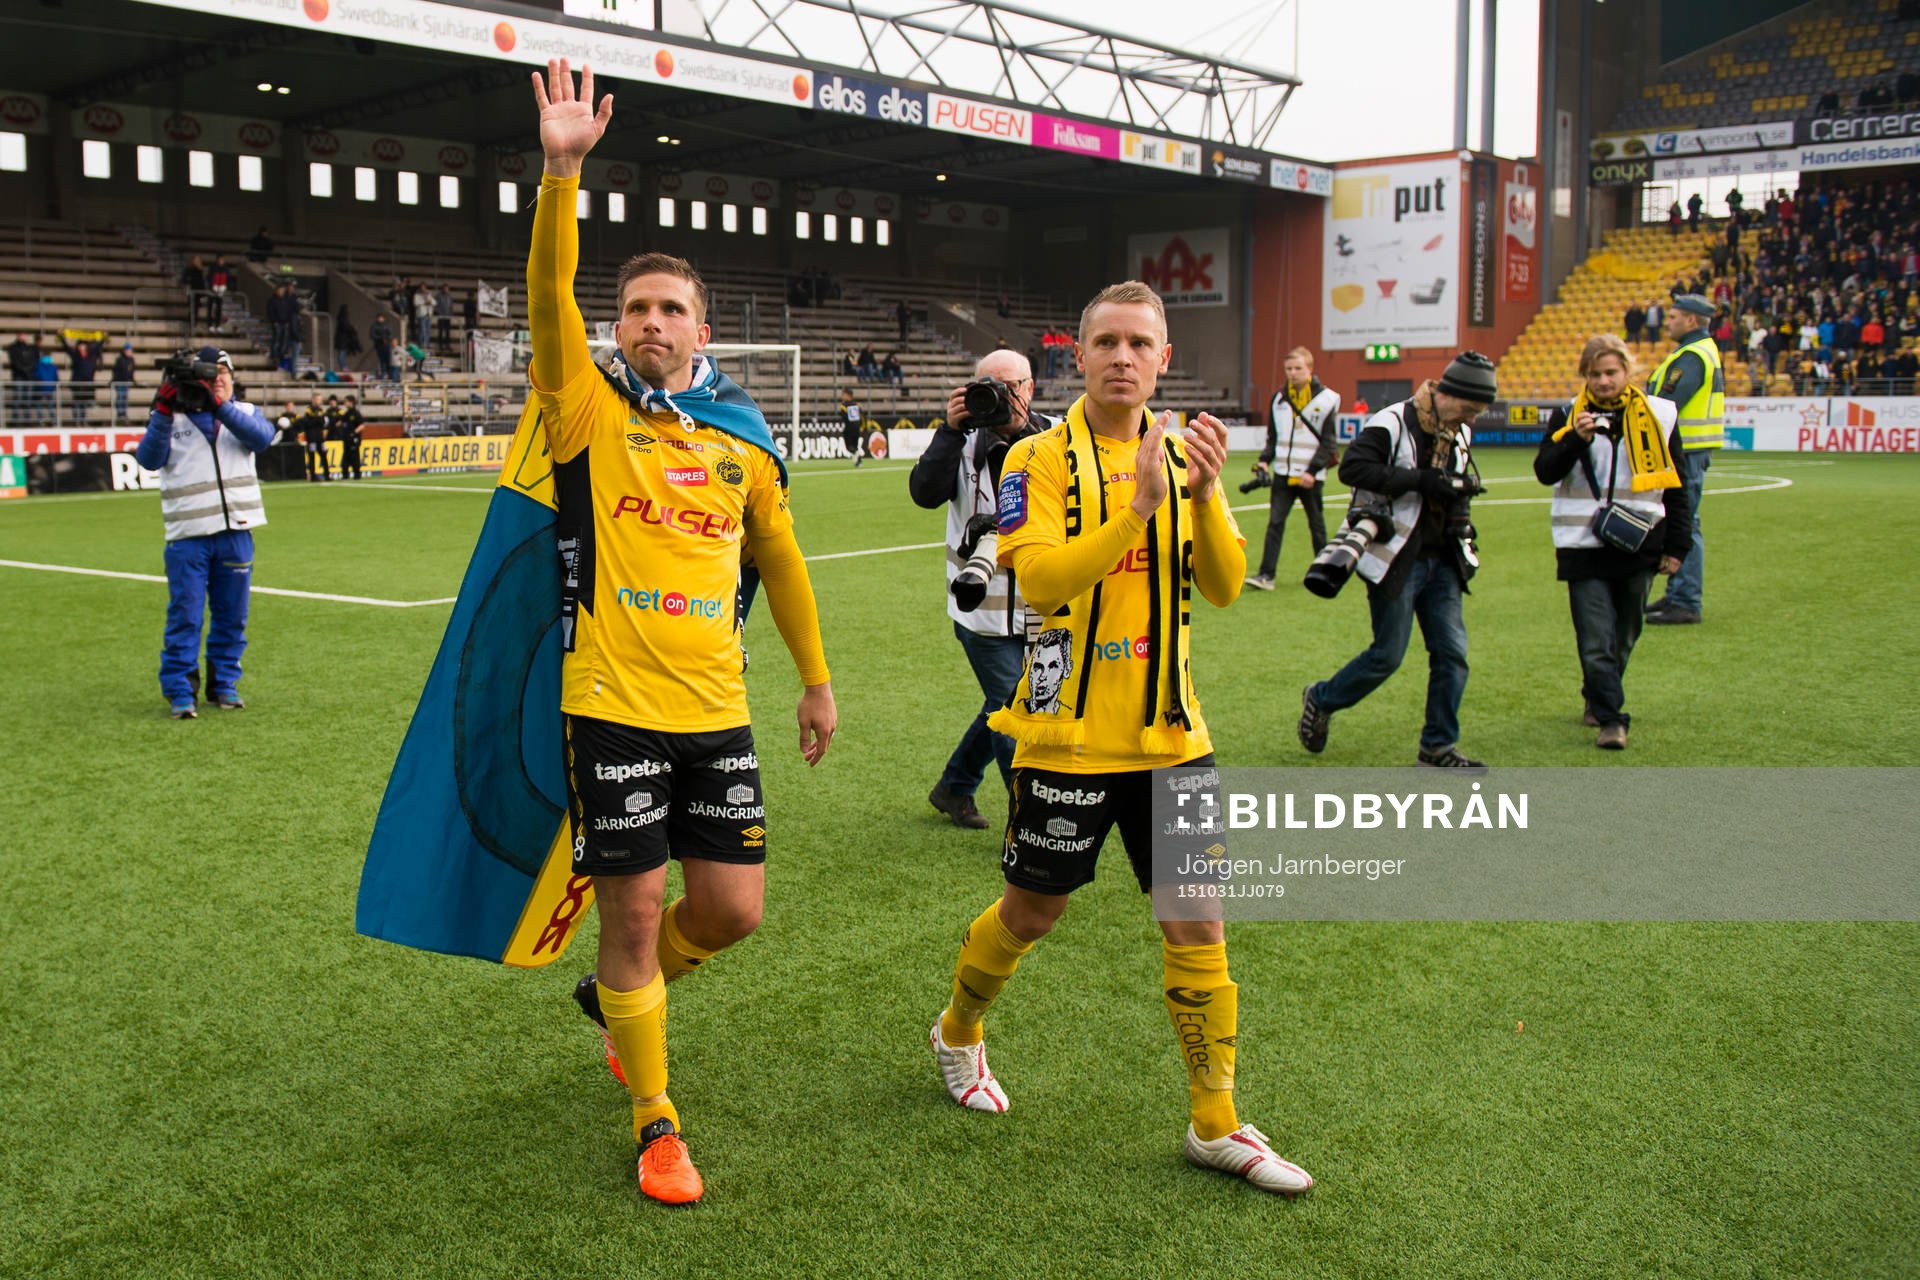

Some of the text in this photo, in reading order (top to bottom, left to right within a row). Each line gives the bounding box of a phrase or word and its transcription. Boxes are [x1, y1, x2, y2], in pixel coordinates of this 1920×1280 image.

[335, 3, 419, 31] Swedbank
[521, 31, 591, 58] Swedbank
[678, 58, 737, 82] Swedbank
[818, 76, 923, 124] ellos ellos
[935, 99, 1025, 138] PULSEN
[1053, 122, 1101, 152] Folksam
[1592, 162, 1648, 182] onyx
[1142, 234, 1214, 293] MAX
[1798, 428, 1920, 452] PLANTAGE
[666, 471, 706, 482] STAPLES
[613, 495, 738, 541] PULSEN
[617, 586, 722, 618] net on net
[574, 836, 585, 862] 8
[1002, 838, 1018, 867] 15
[1175, 1012, 1211, 1077] Ecotec
